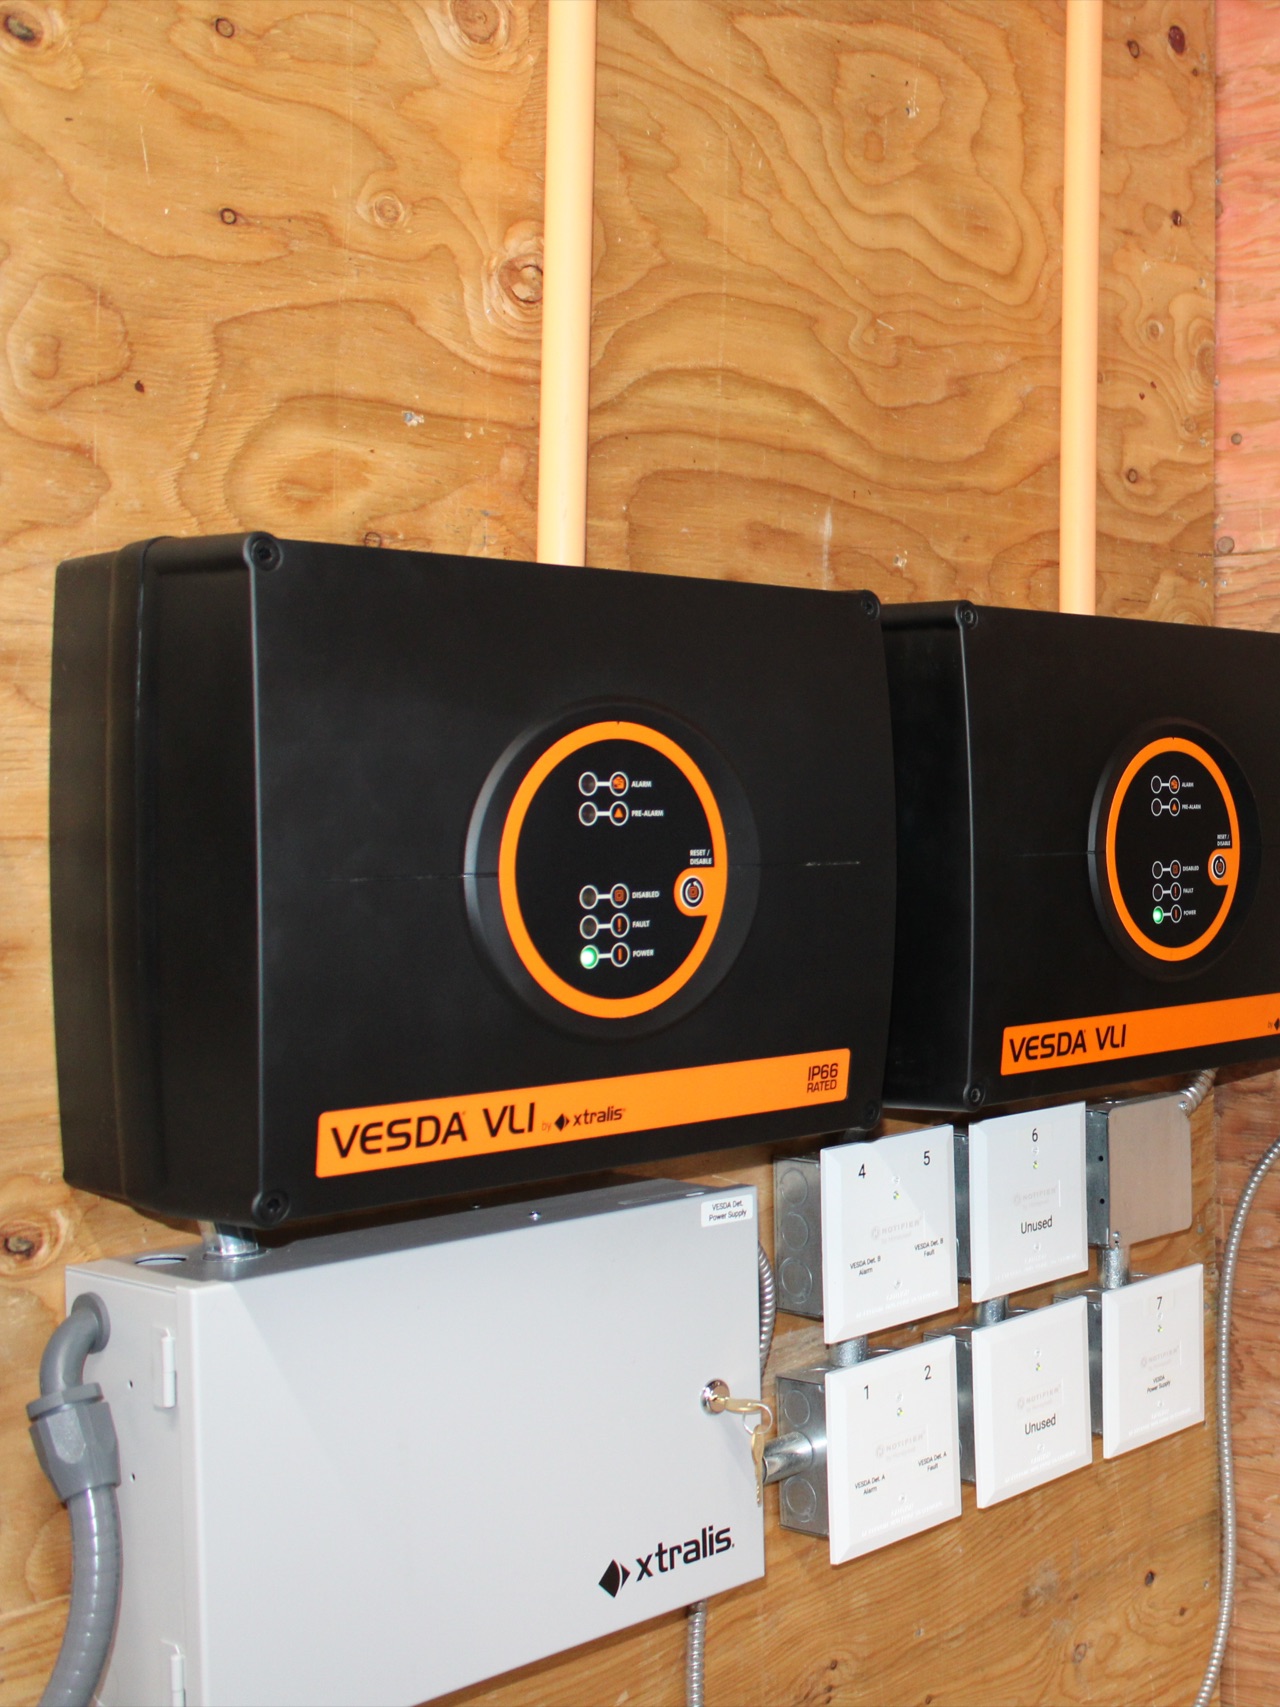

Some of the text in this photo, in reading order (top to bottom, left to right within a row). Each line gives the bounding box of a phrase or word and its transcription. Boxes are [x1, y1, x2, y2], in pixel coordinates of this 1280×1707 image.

[631, 780, 652, 788] ALARM
[631, 809, 664, 817] PRE-ALARM
[690, 849, 706, 857] RESET
[690, 857, 712, 865] DISABLE
[632, 890, 660, 899] DISABLED
[632, 920, 650, 928] FAULT
[633, 949, 654, 958] POWER
[1009, 1029, 1087, 1063] VESDA
[1096, 1024, 1127, 1050] VLI
[807, 1062, 839, 1082] IP66
[806, 1078, 838, 1093] RATED
[331, 1112, 468, 1158] VESDA
[483, 1102, 536, 1137] VLI
[572, 1106, 623, 1127] xtralis
[1031, 1128, 1039, 1143] 6
[858, 1150, 932, 1179] 4 5
[712, 1202, 731, 1211] VESDA
[709, 1209, 747, 1221] Power Supply
[1020, 1214, 1053, 1235] Unused
[914, 1241, 930, 1251] VESDA
[924, 1249, 935, 1257] Fault
[850, 1258, 866, 1270] VESDA
[859, 1267, 873, 1276] Alarm
[1156, 1296, 1163, 1310] 7
[863, 1365, 932, 1400] 1 2
[1024, 1413, 1056, 1435] Unused
[918, 1456, 933, 1467] VESDA
[927, 1463, 939, 1472] Fault
[855, 1478, 871, 1489] VESDA
[863, 1486, 877, 1495] Alarm
[636, 1525, 732, 1582] xtralis
